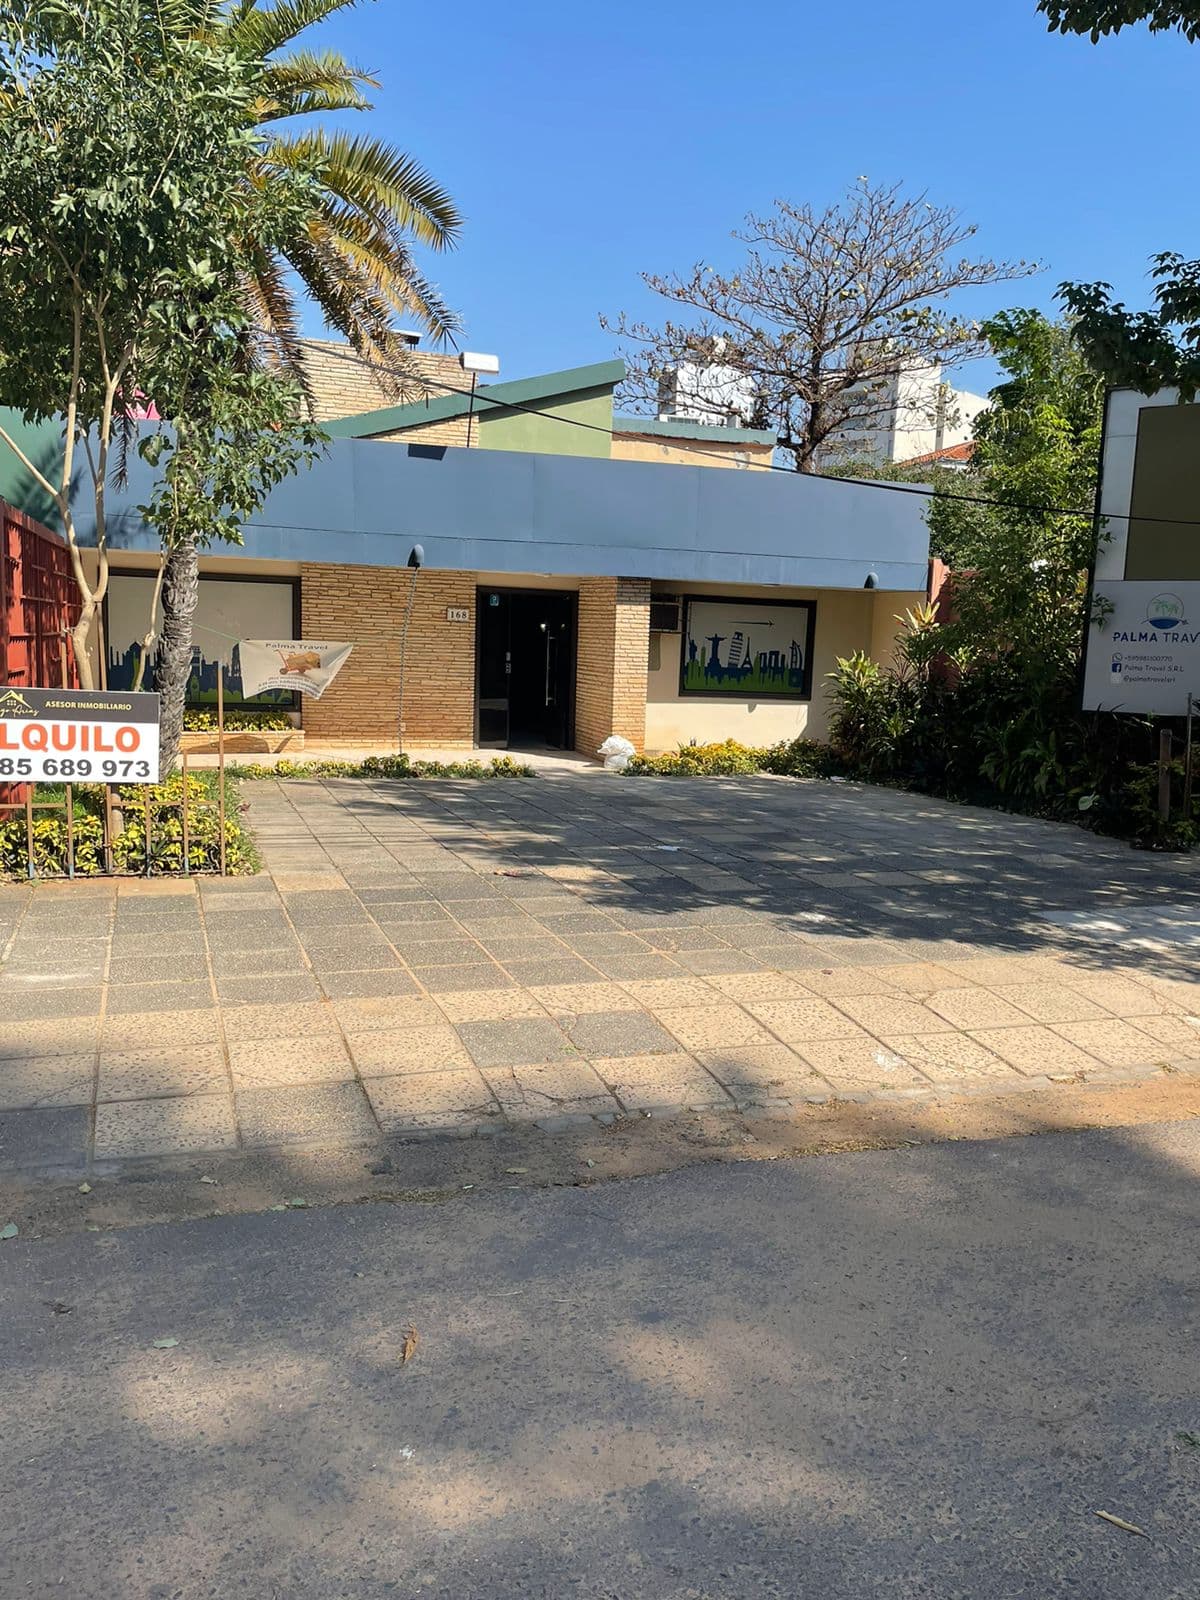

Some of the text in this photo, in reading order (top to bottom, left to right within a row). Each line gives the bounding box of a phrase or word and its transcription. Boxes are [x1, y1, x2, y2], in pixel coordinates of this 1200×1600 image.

[450, 611, 467, 619] 168
[1112, 632, 1158, 642] PALMA
[1145, 664, 1166, 672] Travel
[45, 700, 132, 711] ASESOR INMOBILIARIO
[42, 758, 92, 777] 689
[102, 760, 150, 778] 973
